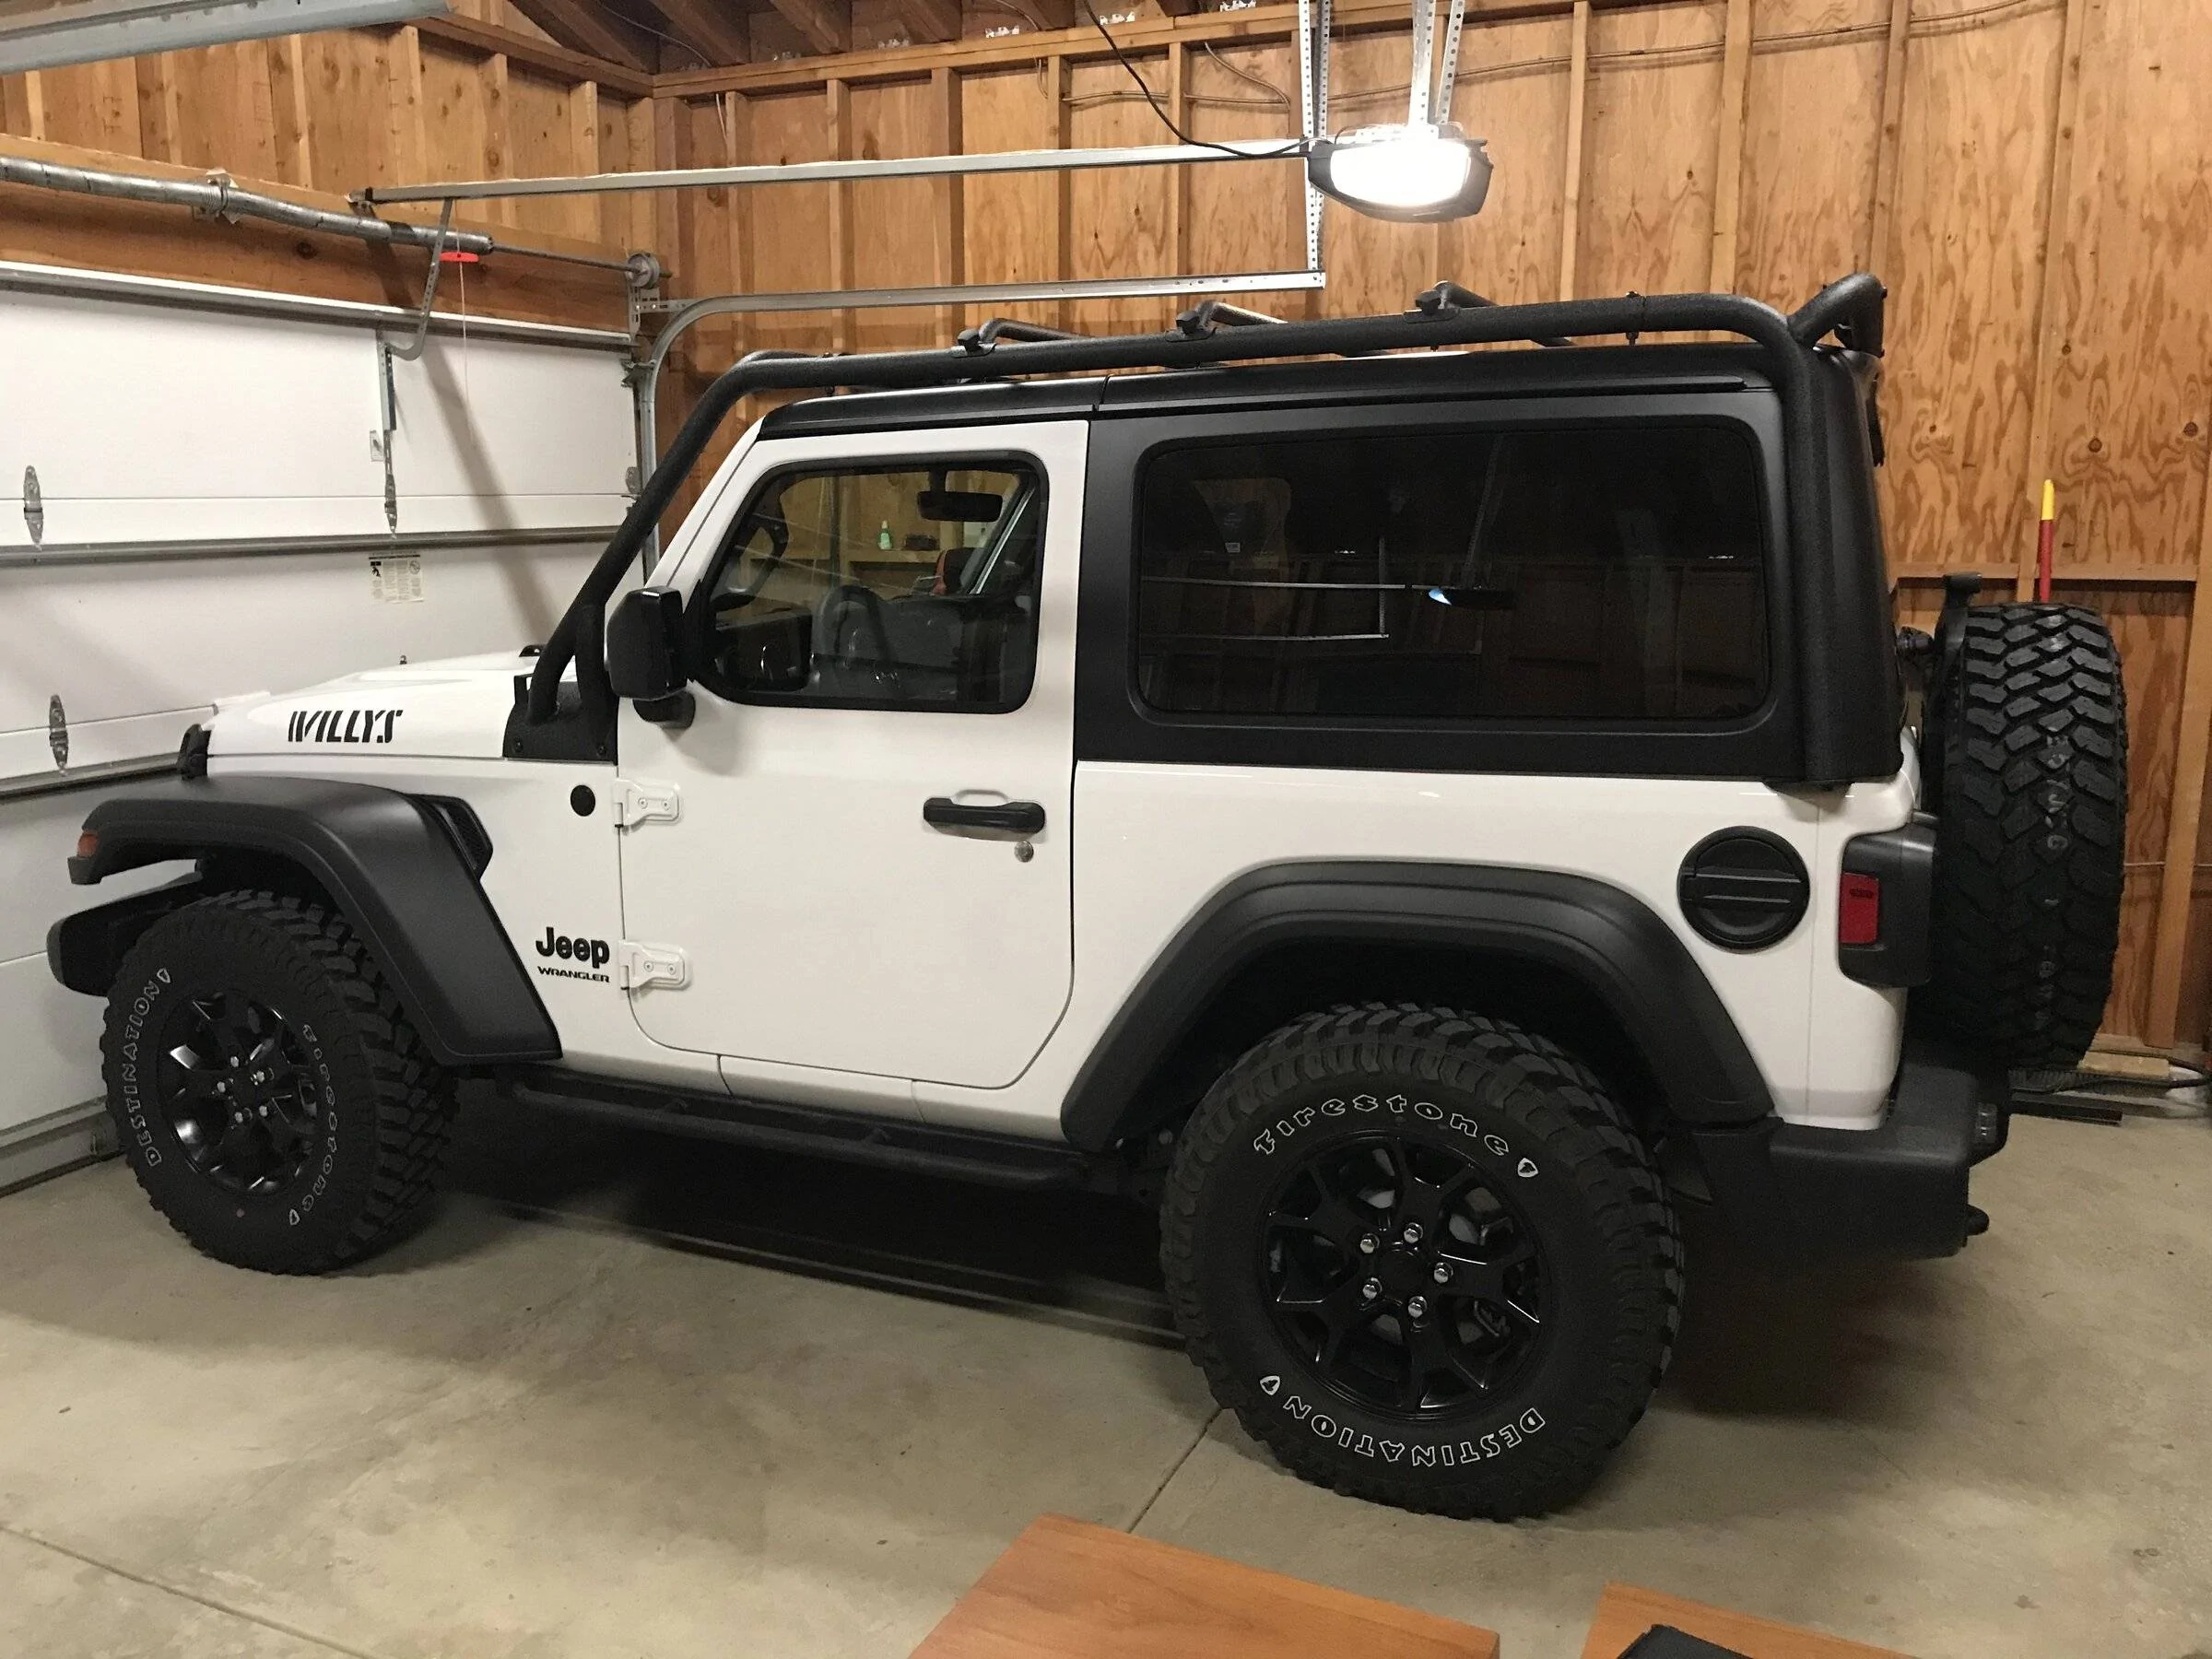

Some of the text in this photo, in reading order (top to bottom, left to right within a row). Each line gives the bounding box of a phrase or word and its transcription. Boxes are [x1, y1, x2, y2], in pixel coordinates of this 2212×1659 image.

[288, 710, 404, 744] WILLYS
[535, 926, 610, 970] Jeep
[536, 965, 610, 983] WRANGLER
[122, 980, 162, 1168] DESTINATION
[1253, 1093, 1510, 1157] Firestone
[1283, 1395, 1547, 1467] DESTINATION
